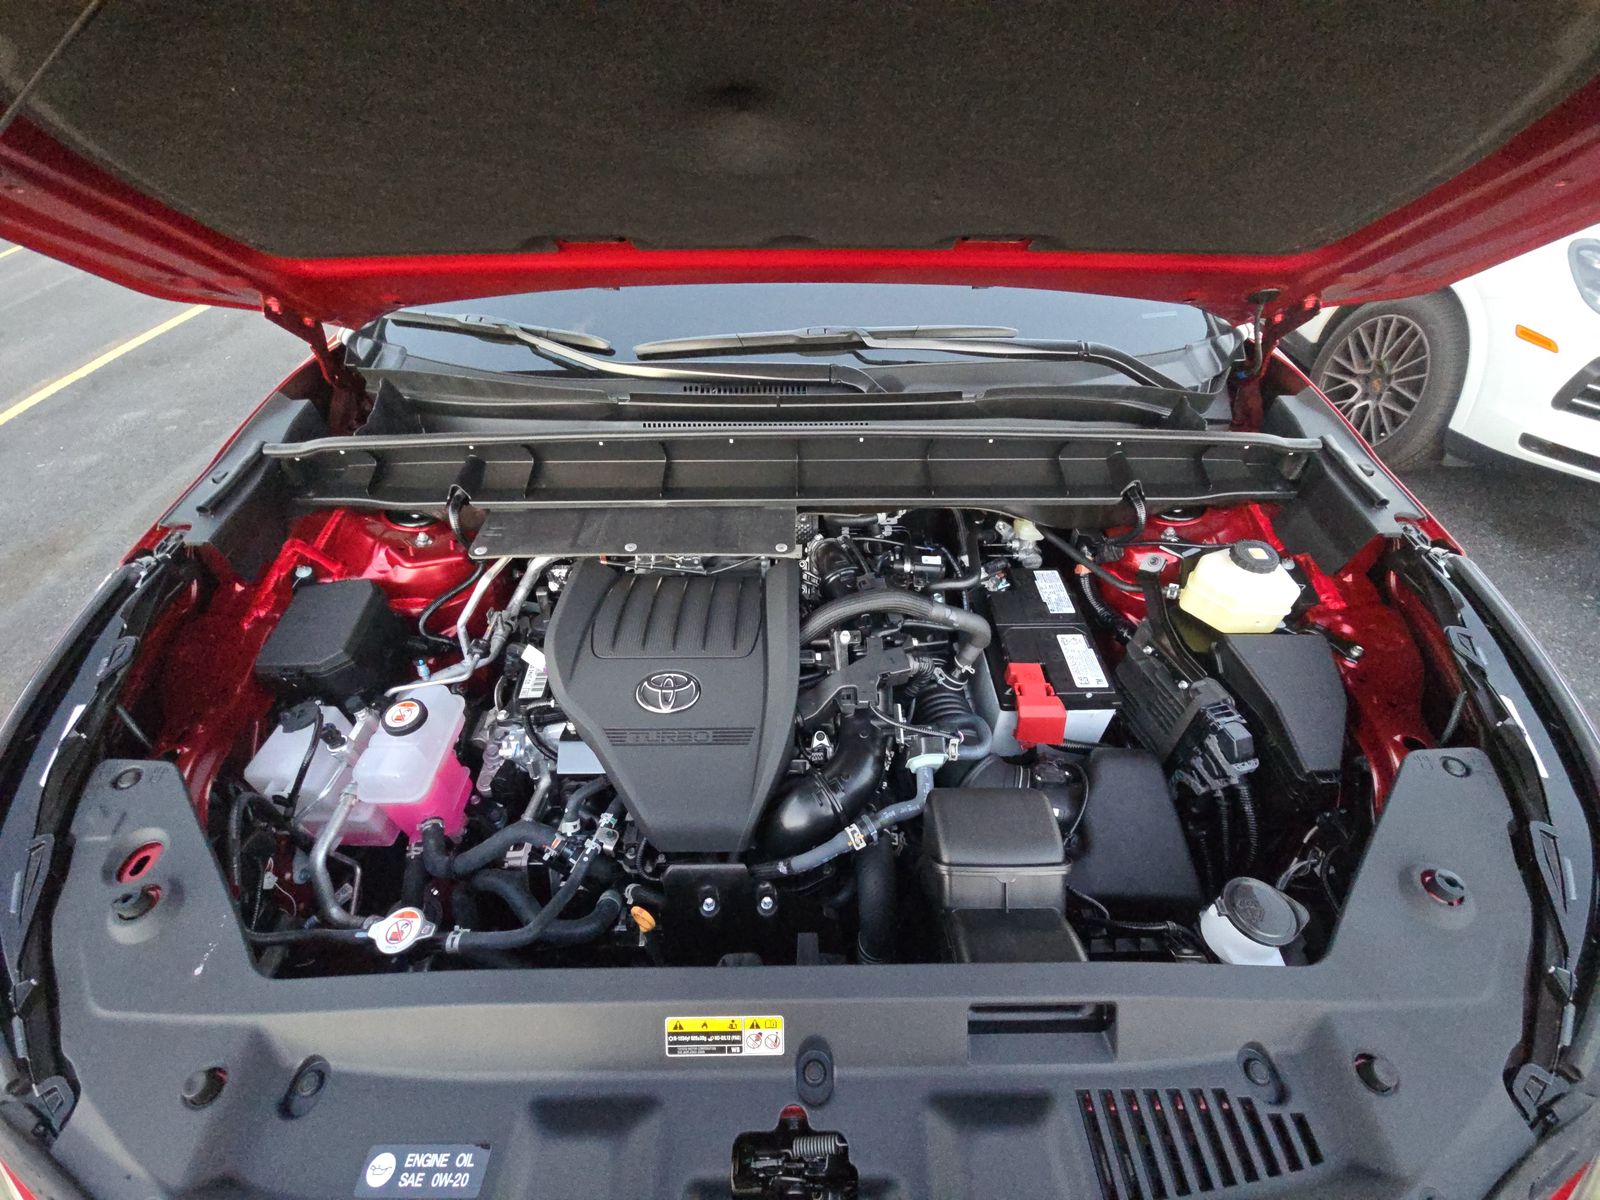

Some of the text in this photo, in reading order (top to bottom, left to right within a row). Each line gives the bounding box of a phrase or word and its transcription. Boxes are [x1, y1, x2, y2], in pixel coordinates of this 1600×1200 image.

[628, 730, 710, 743] TURBO
[404, 1153, 475, 1168] ENGINE OIL
[398, 1172, 470, 1188] SAE 0W-20
